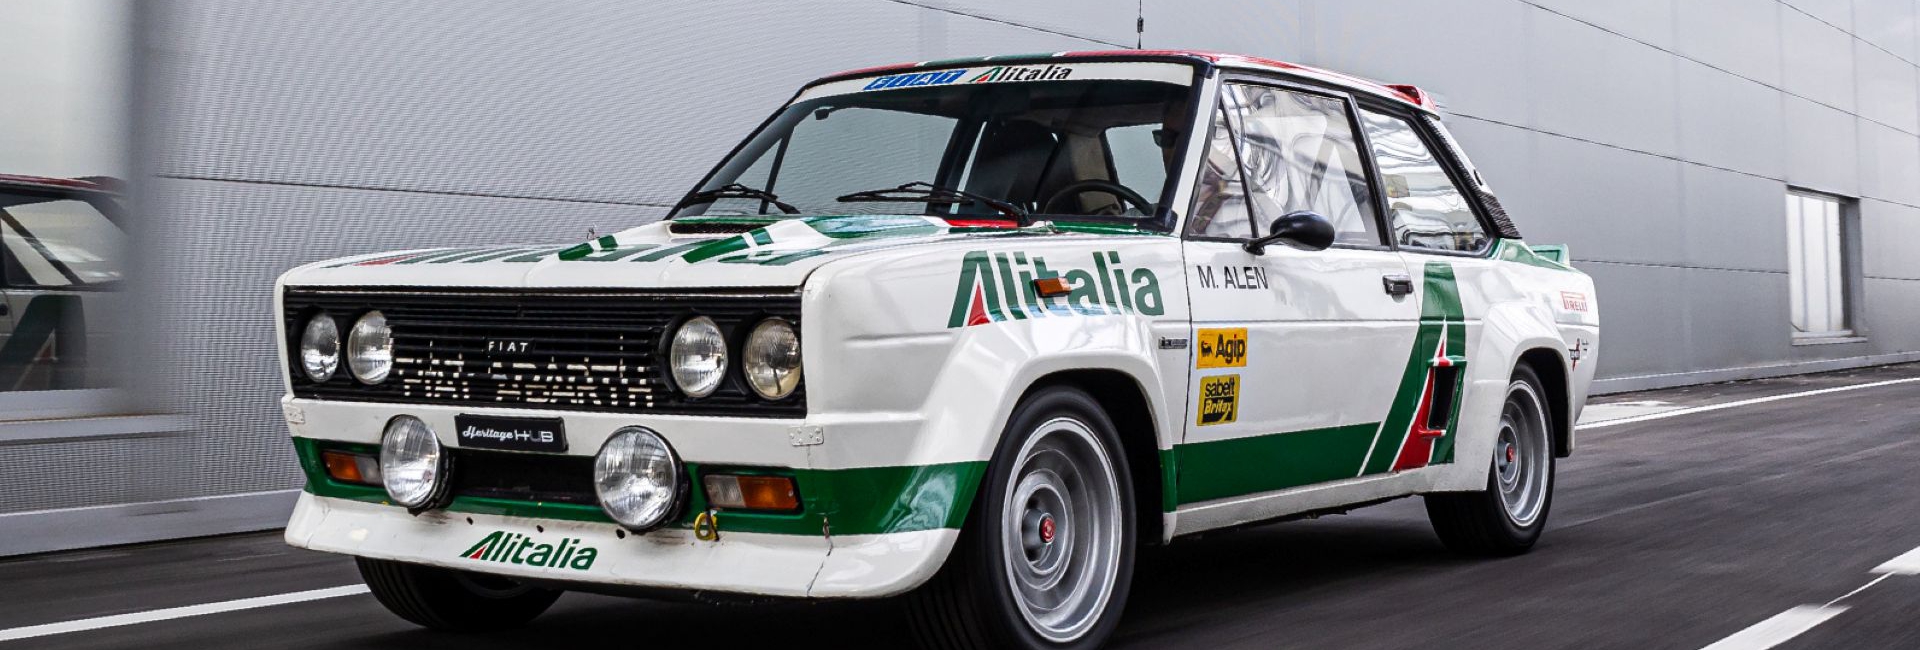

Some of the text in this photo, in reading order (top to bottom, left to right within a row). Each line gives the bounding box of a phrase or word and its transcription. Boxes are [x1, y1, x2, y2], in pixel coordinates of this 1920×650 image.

[864, 69, 968, 91] FIAT
[970, 66, 1073, 84] Alitalia
[1197, 266, 1268, 290] M. ALEN
[947, 251, 1165, 328] Alitalia
[488, 341, 529, 352] FIAT
[1215, 333, 1245, 364] Agip
[1204, 377, 1235, 397] sabelt
[462, 425, 554, 443] Heritage HUB
[460, 530, 598, 570] Alitalia
